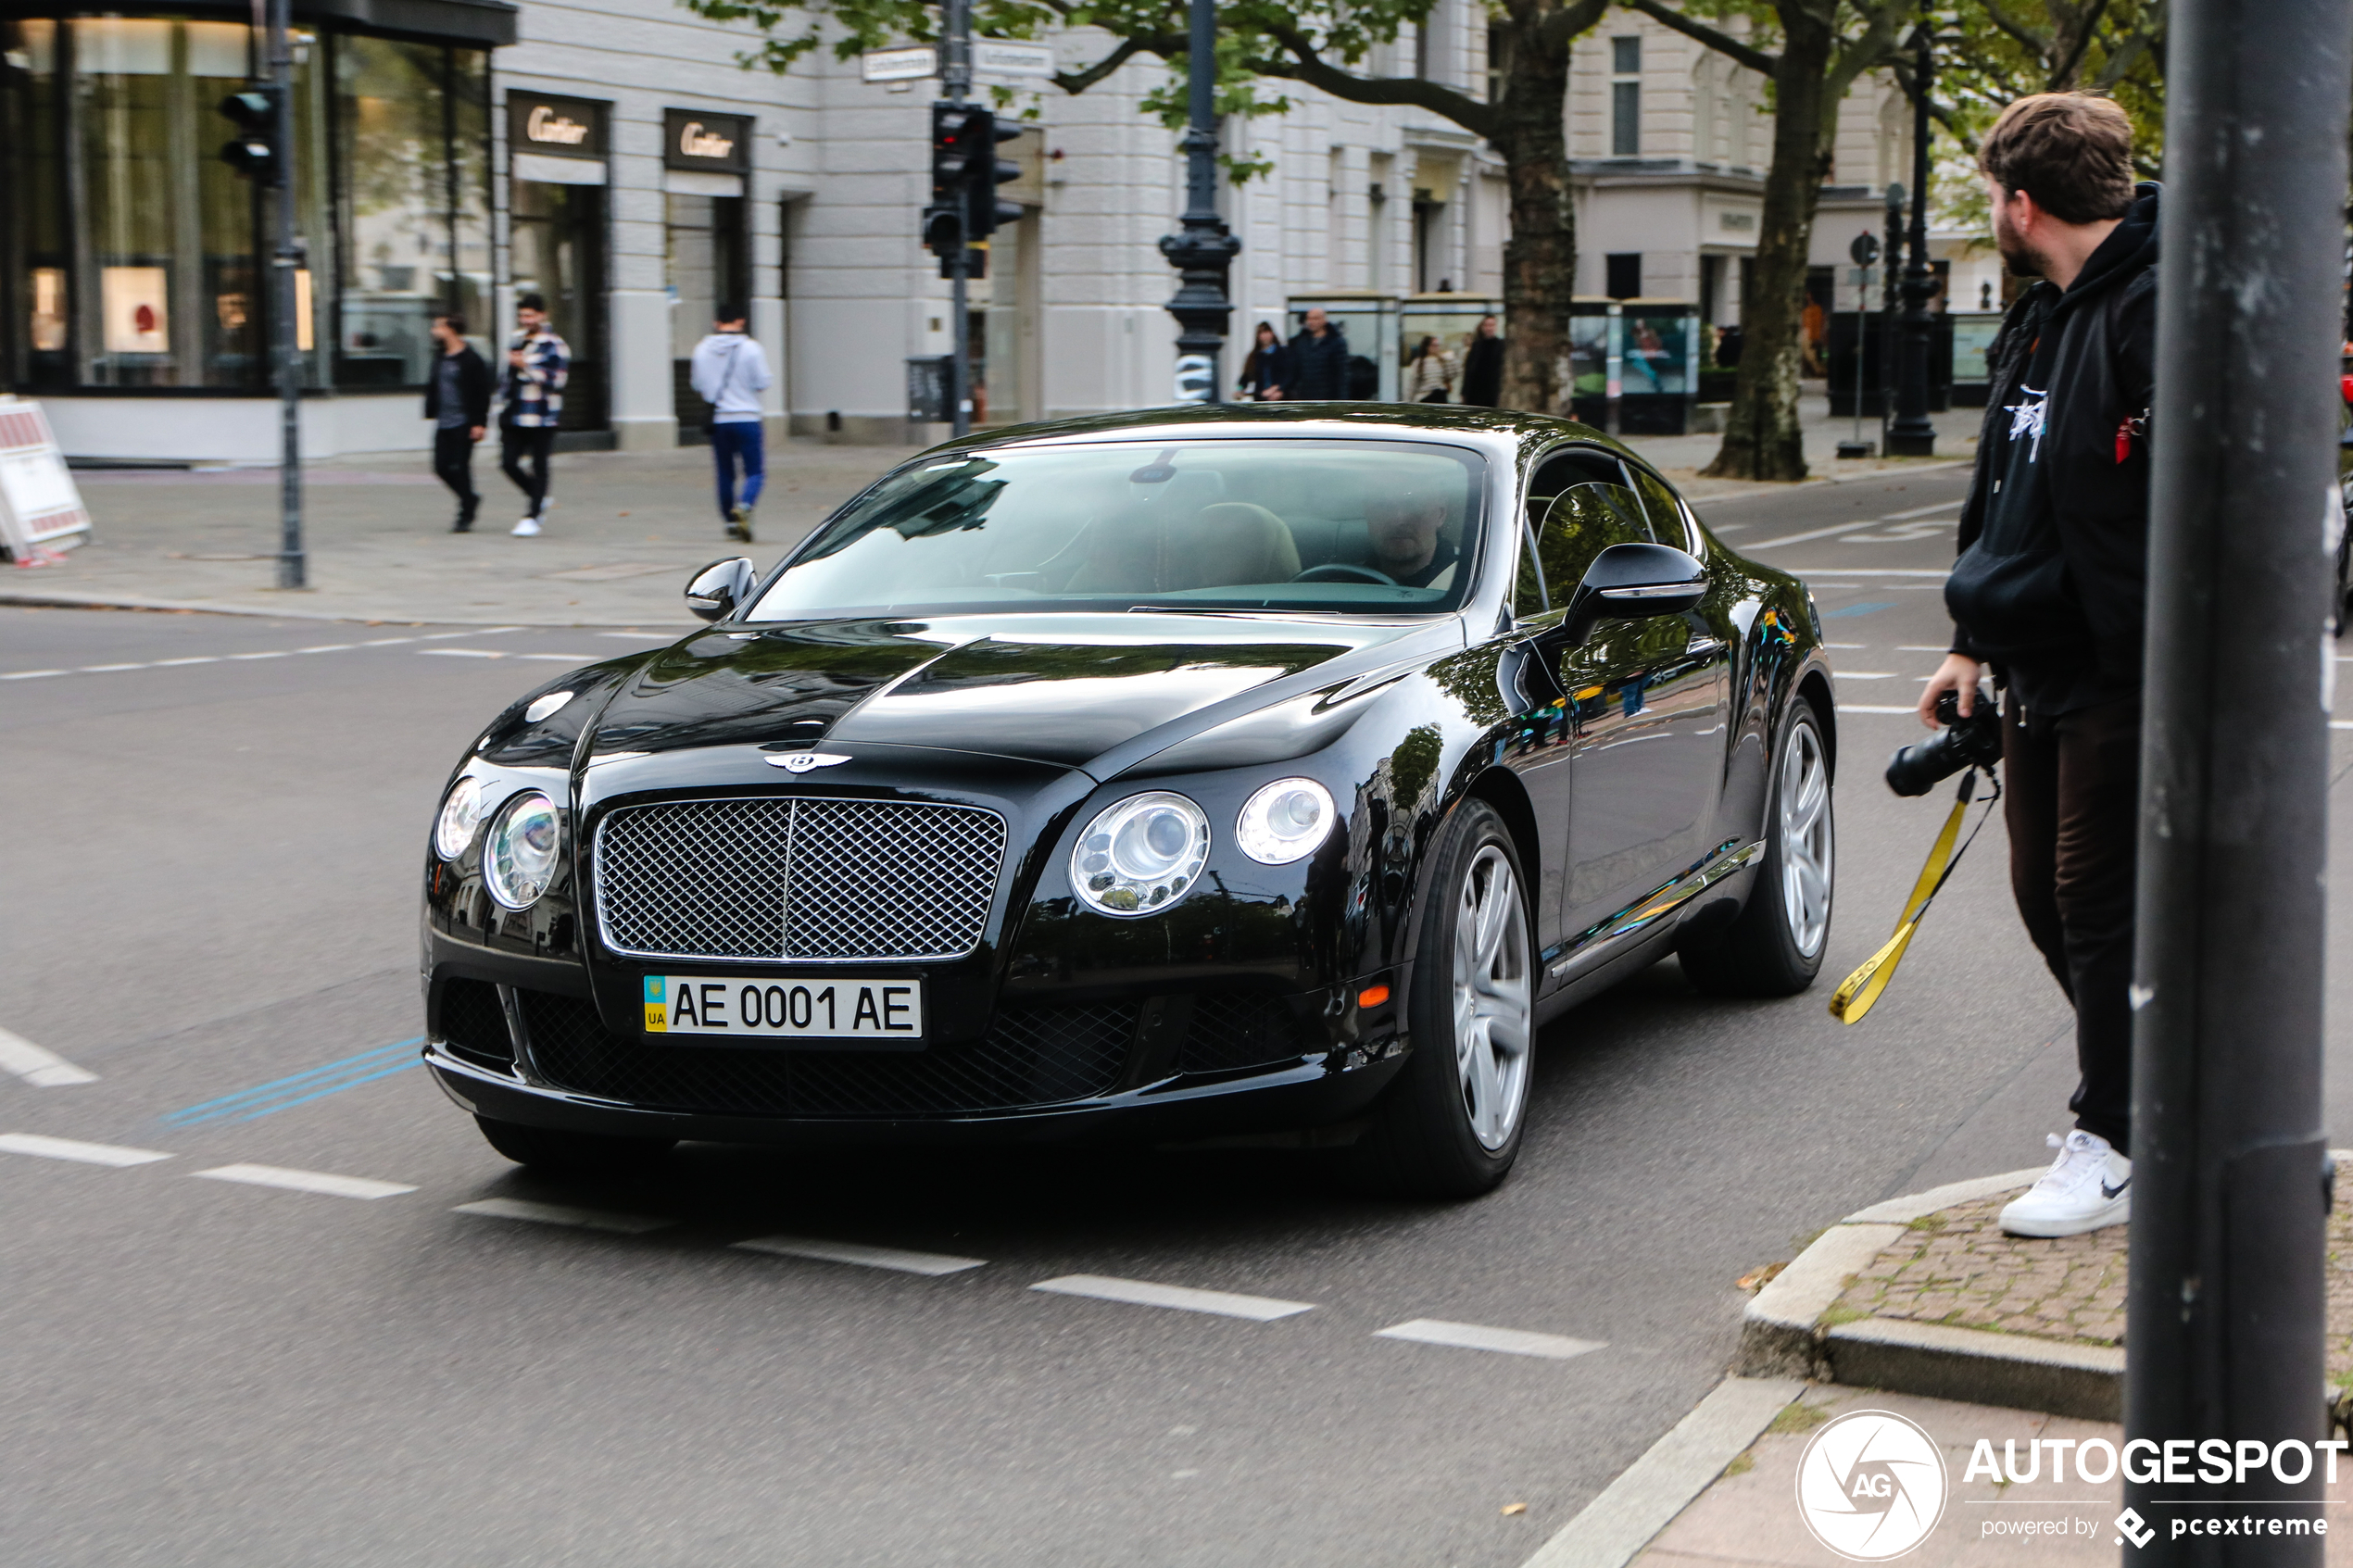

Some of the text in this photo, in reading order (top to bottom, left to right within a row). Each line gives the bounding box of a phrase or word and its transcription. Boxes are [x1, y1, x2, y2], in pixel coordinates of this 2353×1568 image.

[527, 106, 588, 144] Cartier
[680, 122, 734, 157] Cartier
[648, 1012, 665, 1024] UA
[673, 984, 913, 1030] AE 0001 AE
